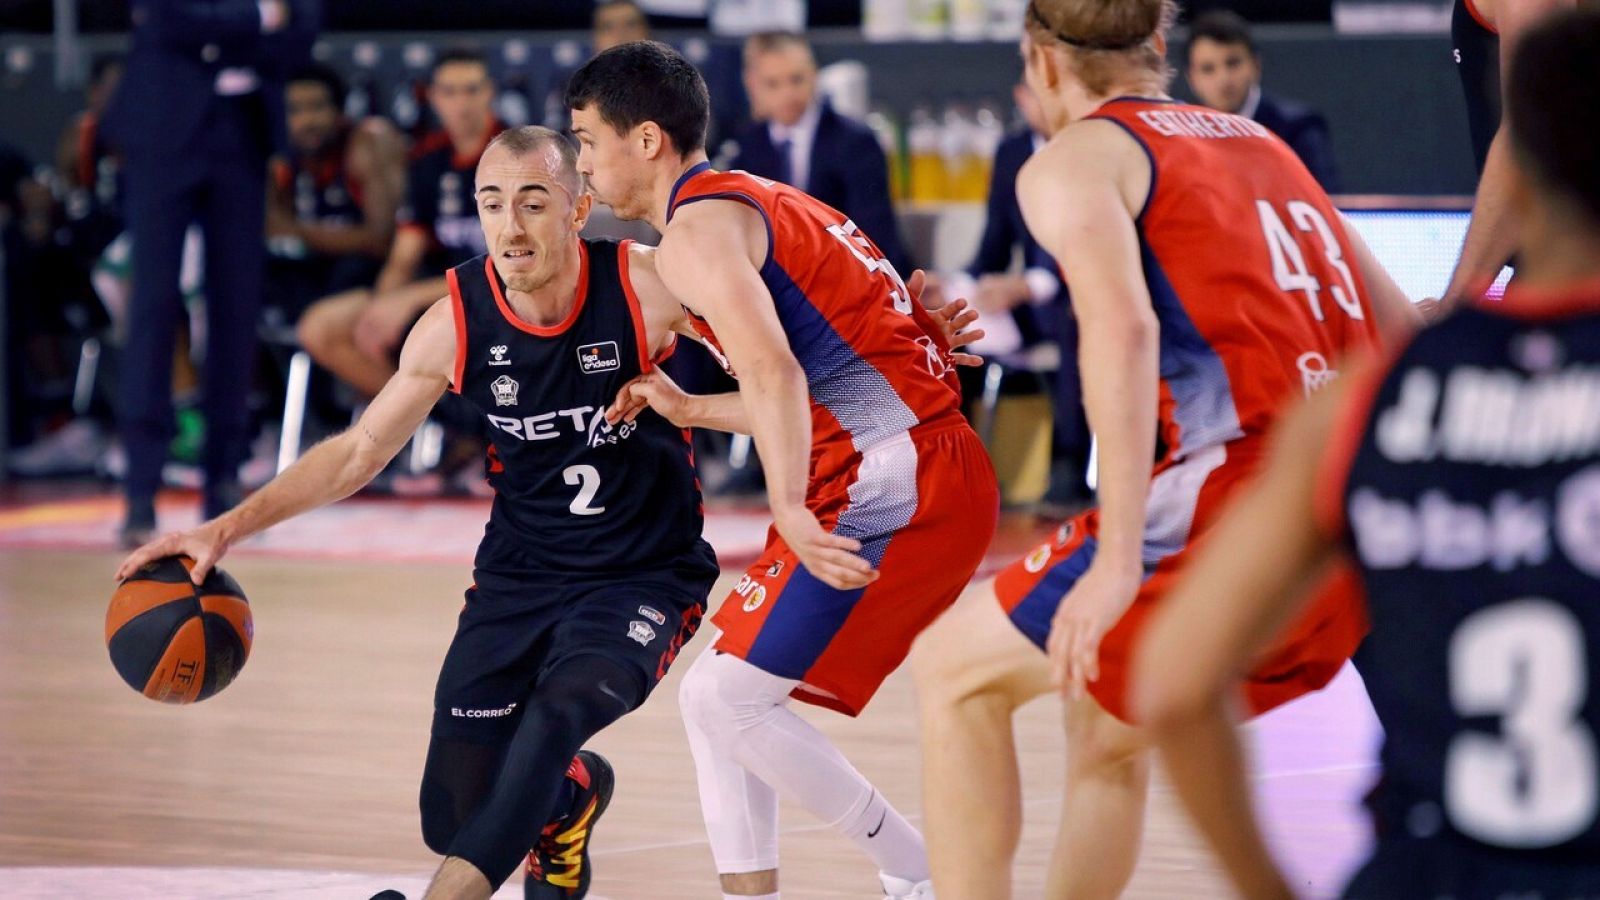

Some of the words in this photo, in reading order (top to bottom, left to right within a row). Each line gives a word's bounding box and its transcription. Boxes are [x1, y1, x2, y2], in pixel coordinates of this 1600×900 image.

[1136, 110, 1269, 138] EATHERTO
[1255, 199, 1365, 321] 43
[562, 464, 606, 516] 2
[1446, 597, 1599, 849] 3
